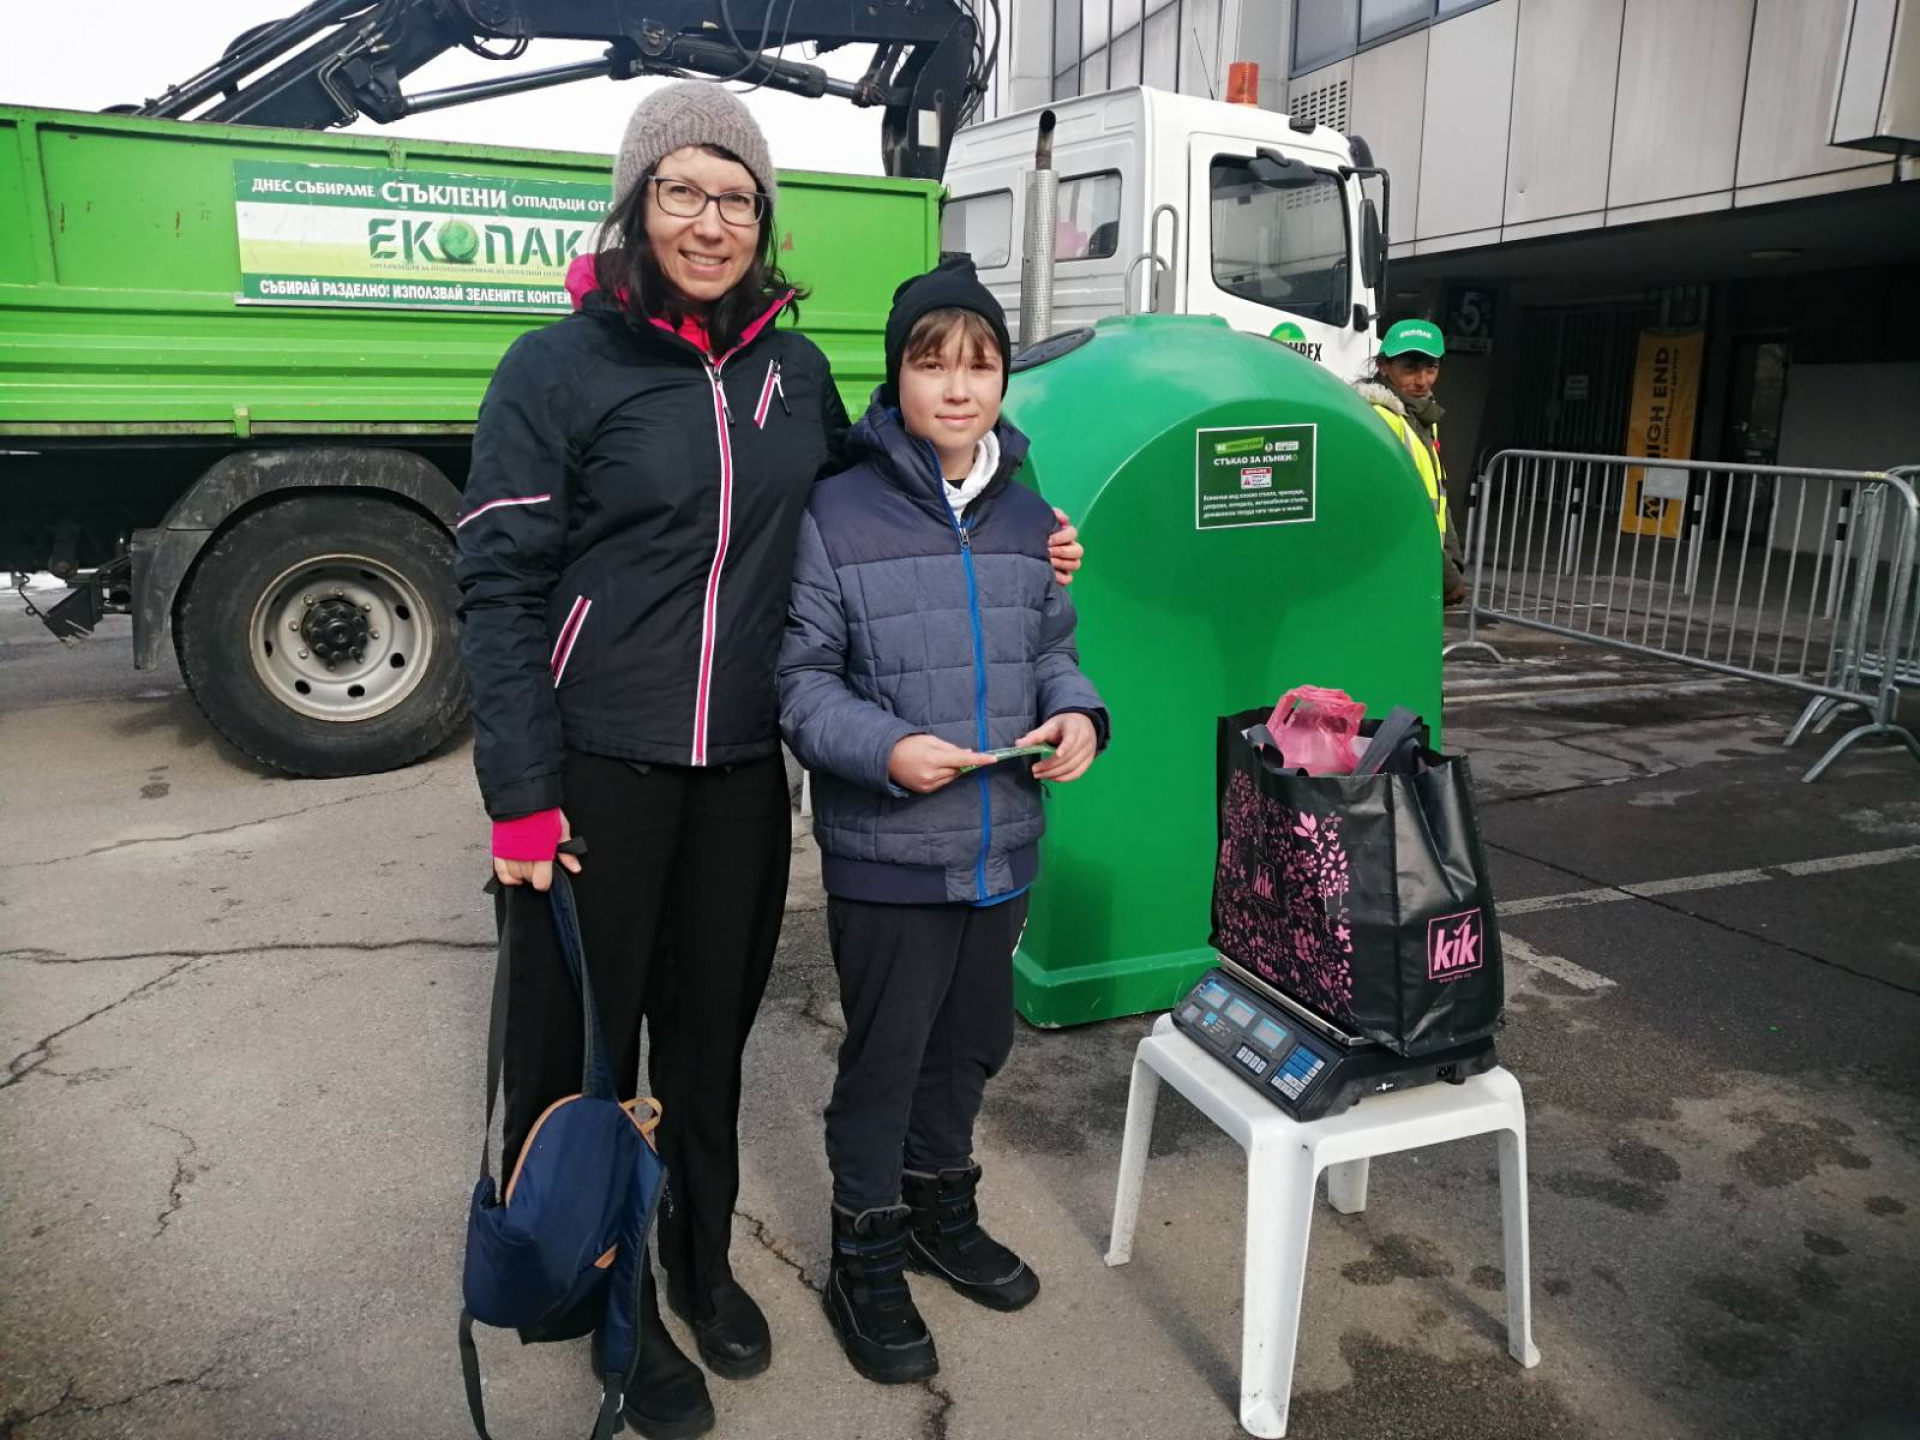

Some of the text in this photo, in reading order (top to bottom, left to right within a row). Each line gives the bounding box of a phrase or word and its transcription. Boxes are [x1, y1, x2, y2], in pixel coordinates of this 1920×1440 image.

[252, 178, 292, 192] ДНЕС
[295, 180, 376, 198] СЪБИРАМЕ
[381, 181, 507, 209] СТЪКЛЕНИ
[512, 194, 585, 213] ОТПАДЪЦИ
[588, 200, 606, 212] ОТ
[368, 218, 585, 267] ЕКОПАК
[259, 278, 571, 304] СЪБИРАЙ РАЗДЕЛНО! ИЗПОЛЗВАЙ ЗЕЛЕНИТЕ КОНТЕЙ
[1459, 291, 1480, 335] 5
[1652, 347, 1669, 398] END
[1249, 455, 1261, 463] ЗА
[1434, 914, 1479, 972] kik
